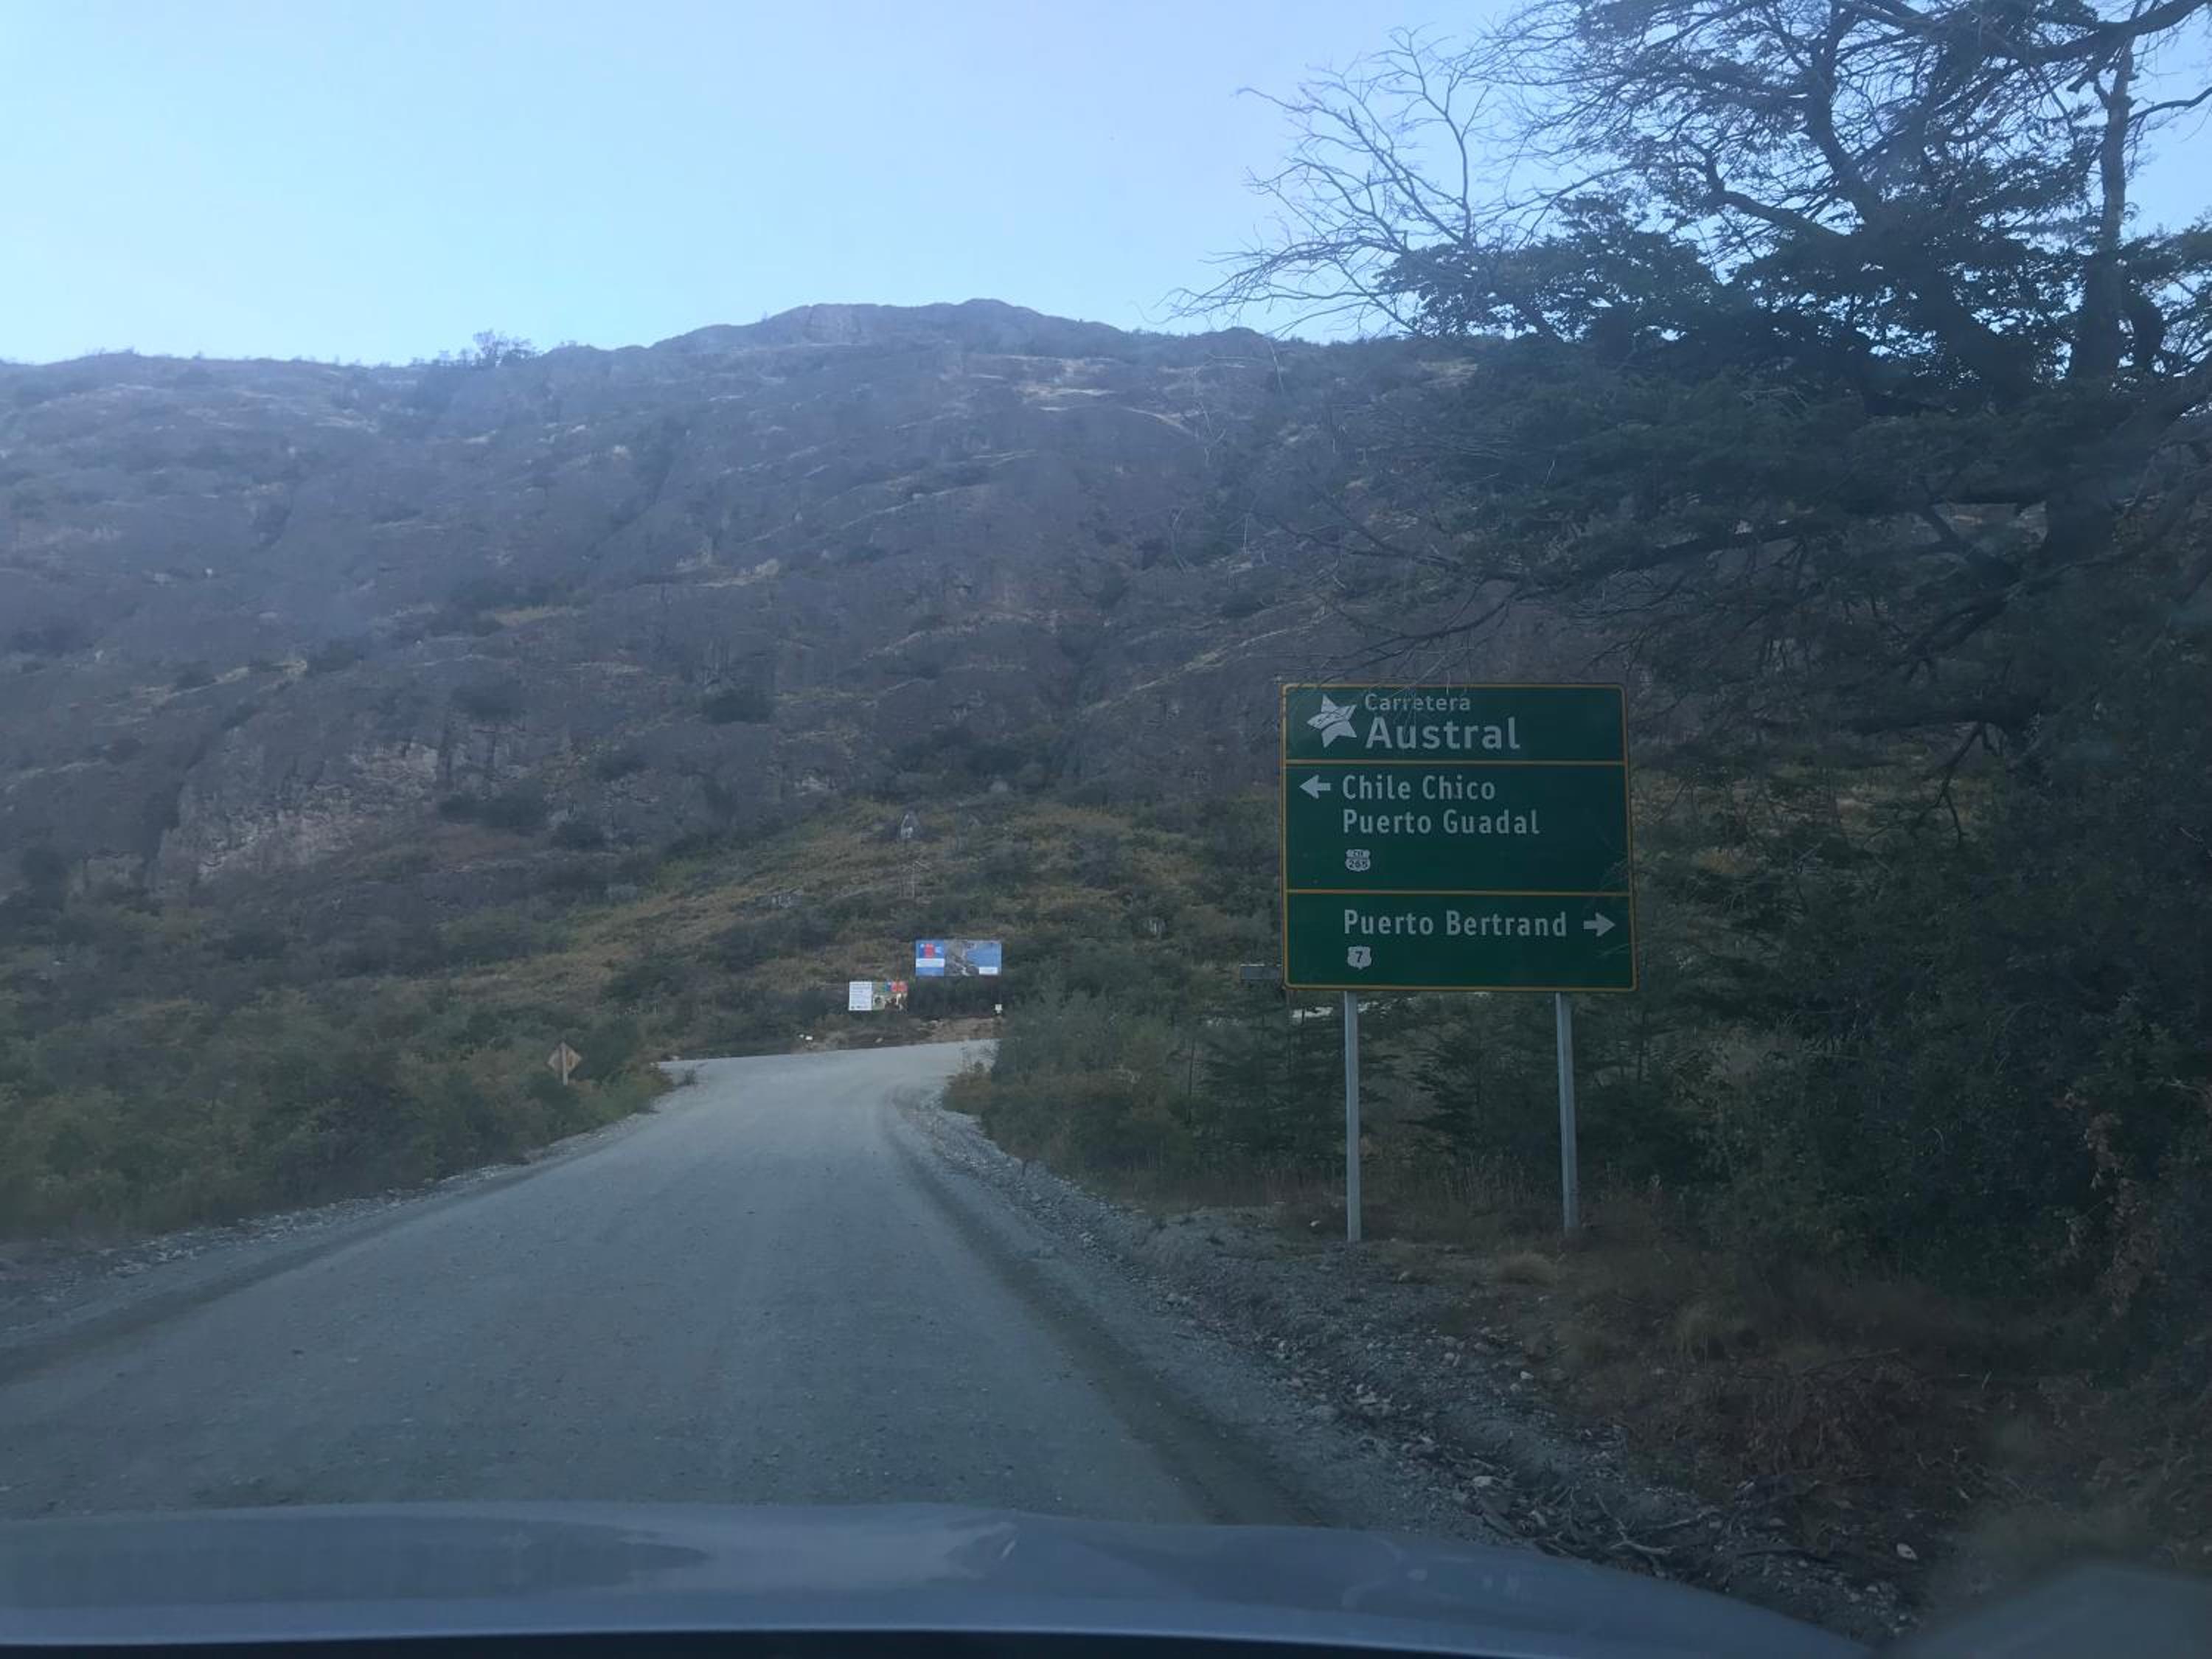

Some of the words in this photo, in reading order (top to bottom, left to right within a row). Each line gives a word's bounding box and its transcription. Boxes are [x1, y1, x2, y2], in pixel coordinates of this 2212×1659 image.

[1365, 694, 1471, 712] Carretera
[1366, 717, 1520, 750] Austral
[1342, 775, 1411, 801] Chile
[1422, 775, 1496, 801] Chico
[1343, 810, 1432, 835] Puerto
[1443, 810, 1540, 835] Guadal
[1344, 910, 1434, 936] Puerto
[1447, 911, 1568, 937] Bertrand
[1355, 951, 1363, 963] 7
